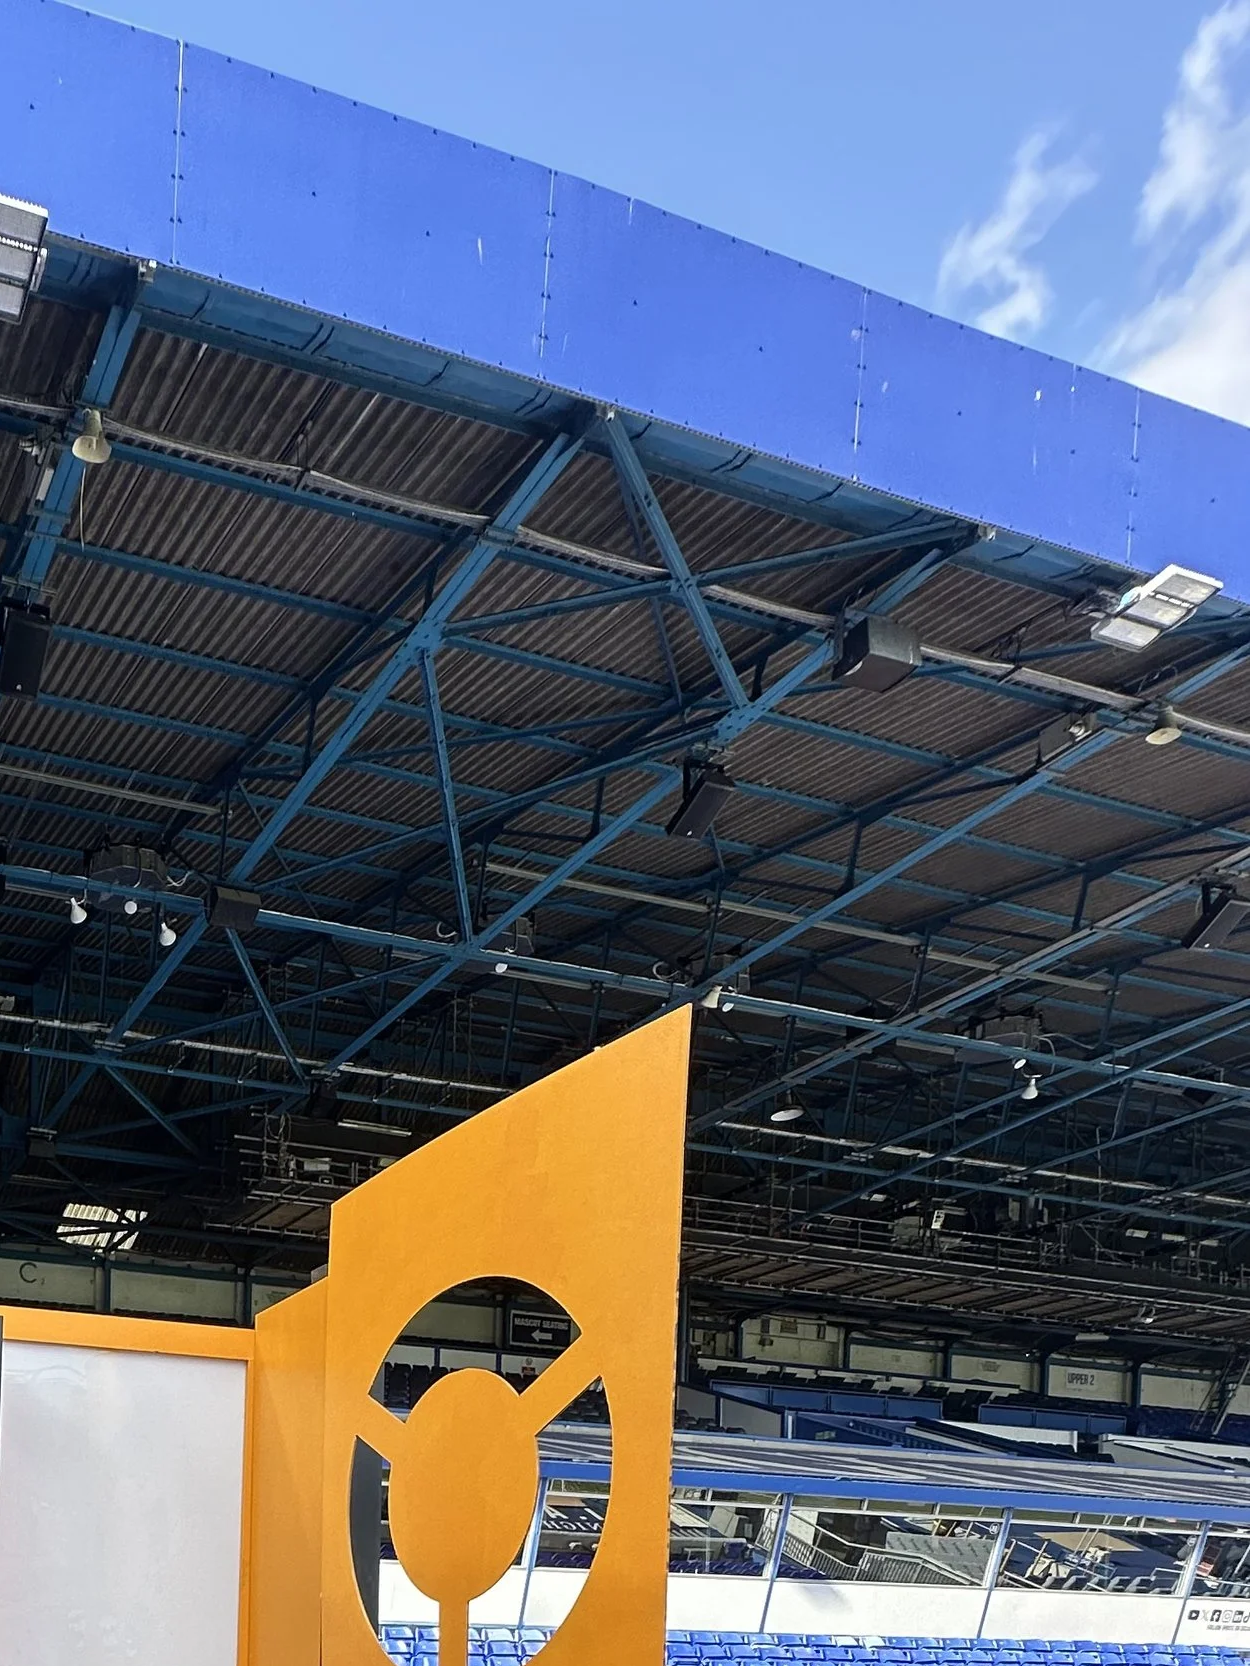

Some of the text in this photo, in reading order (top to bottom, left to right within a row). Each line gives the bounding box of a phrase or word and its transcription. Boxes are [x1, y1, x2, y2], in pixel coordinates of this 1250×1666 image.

[19, 1262, 38, 1283] C
[514, 1317, 569, 1330] MASCOT SEATING
[1067, 1372, 1095, 1386] UPPER 2
